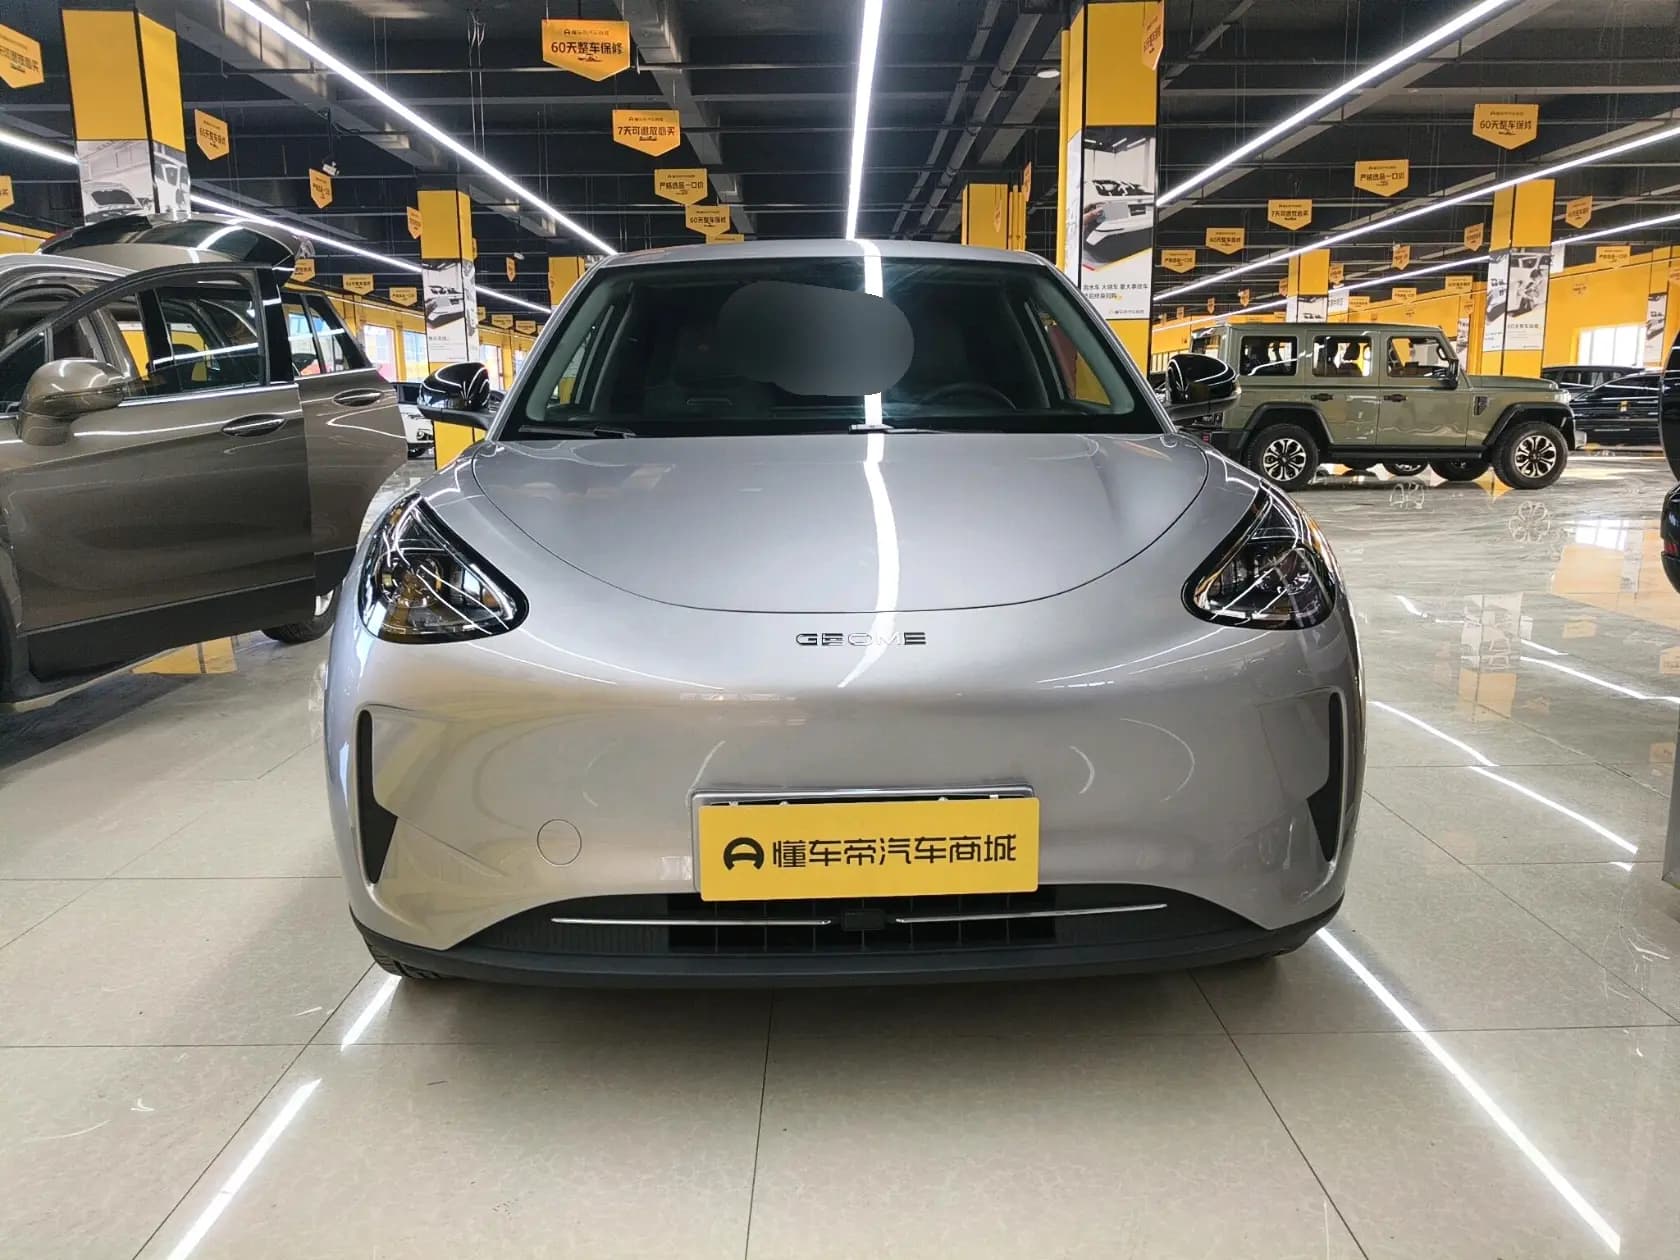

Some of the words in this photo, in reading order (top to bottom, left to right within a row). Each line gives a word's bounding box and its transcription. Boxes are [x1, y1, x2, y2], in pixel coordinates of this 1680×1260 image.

[551, 41, 624, 54] 60天整车保修
[795, 631, 927, 647] GEOME
[772, 834, 1017, 868] 懂车帝汽车商城
